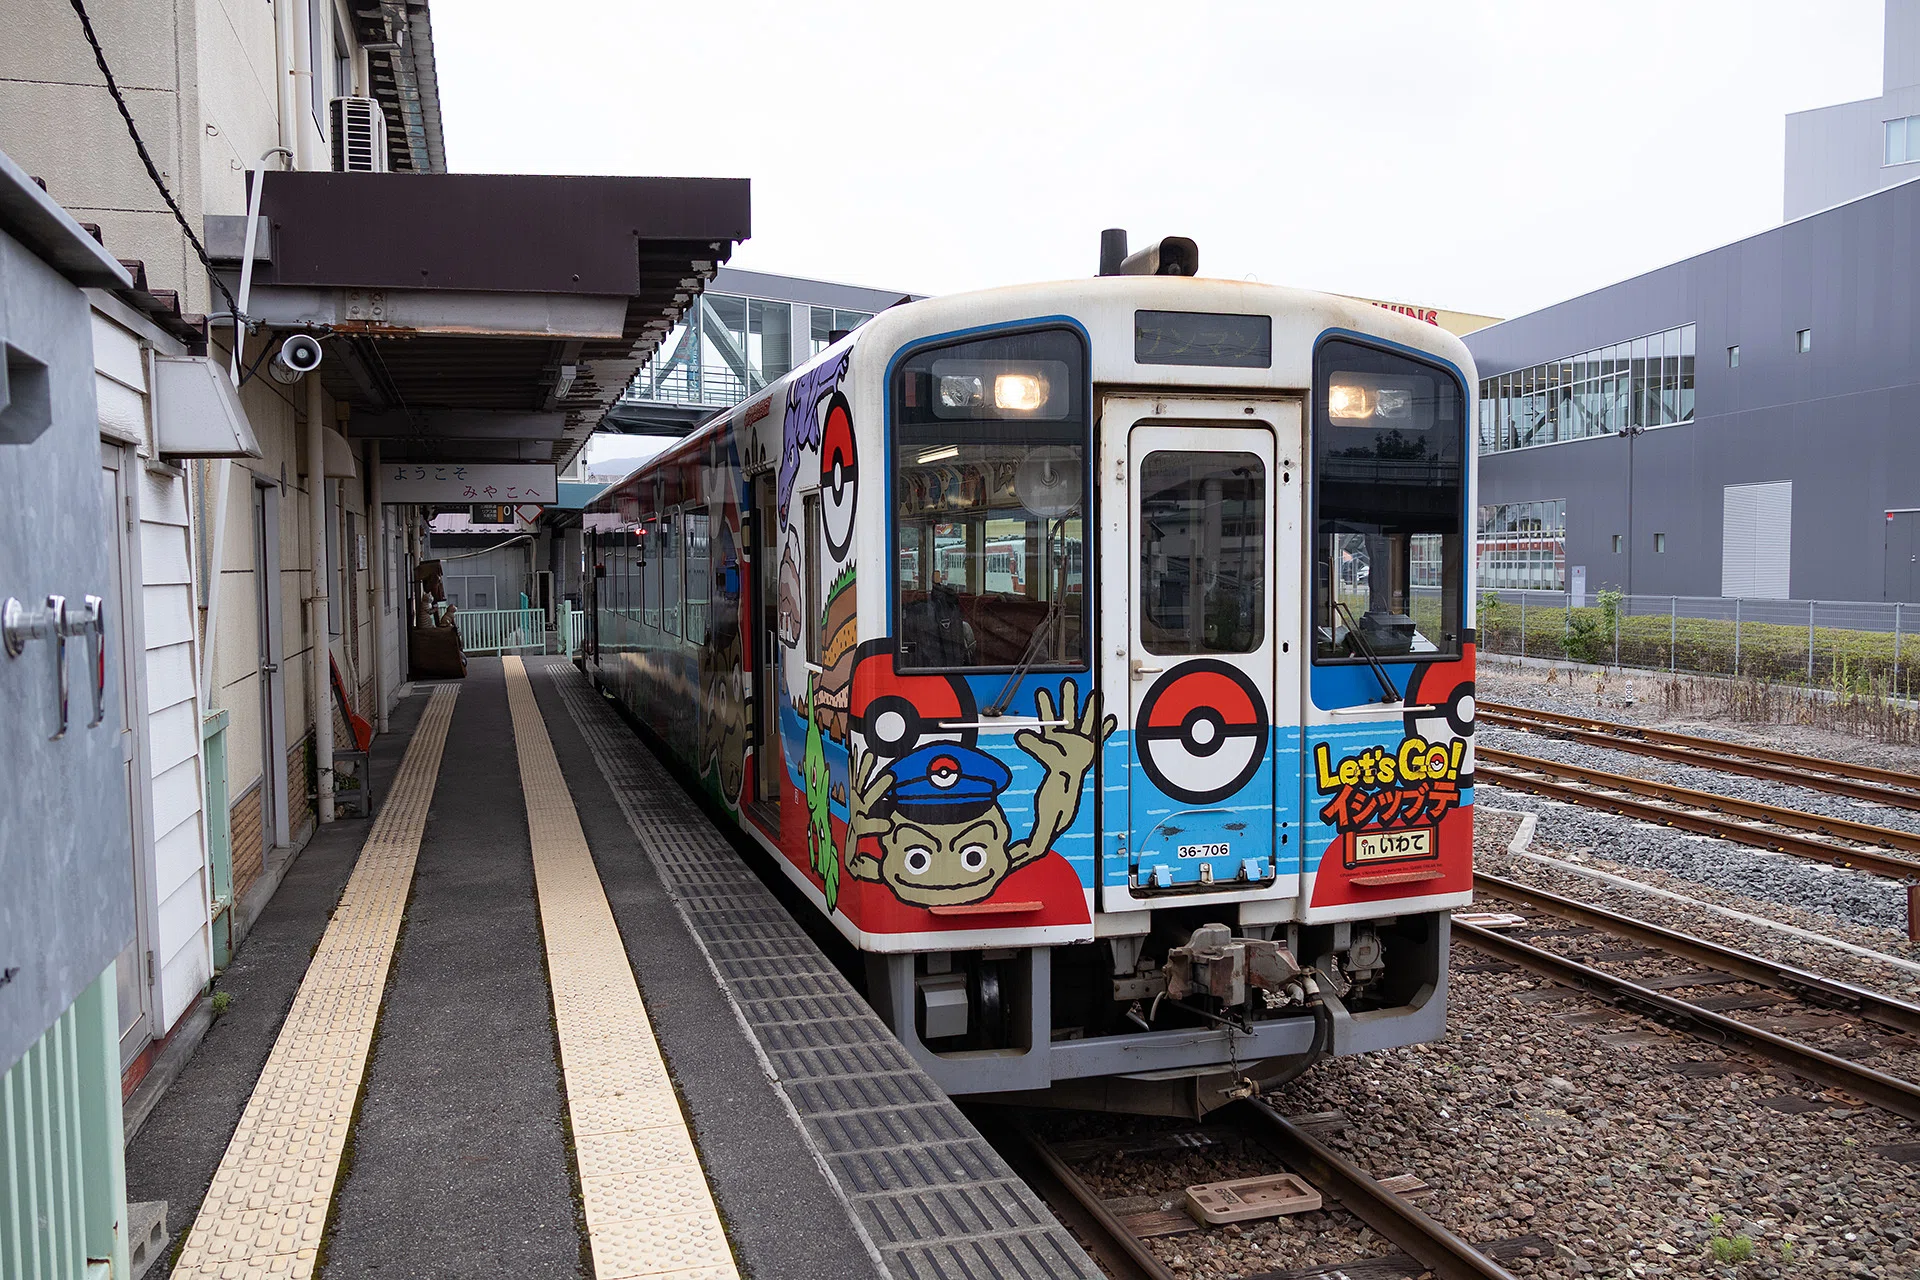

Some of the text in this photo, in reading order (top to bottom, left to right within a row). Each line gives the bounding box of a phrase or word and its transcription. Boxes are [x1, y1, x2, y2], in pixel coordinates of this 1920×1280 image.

[393, 466, 468, 481] ようこそ
[462, 485, 541, 499] みやこへ
[1316, 737, 1464, 789] Let's Go!
[1322, 780, 1460, 827] イシツブテ
[1179, 844, 1228, 858] 36-706
[1361, 834, 1425, 856] in いわて
